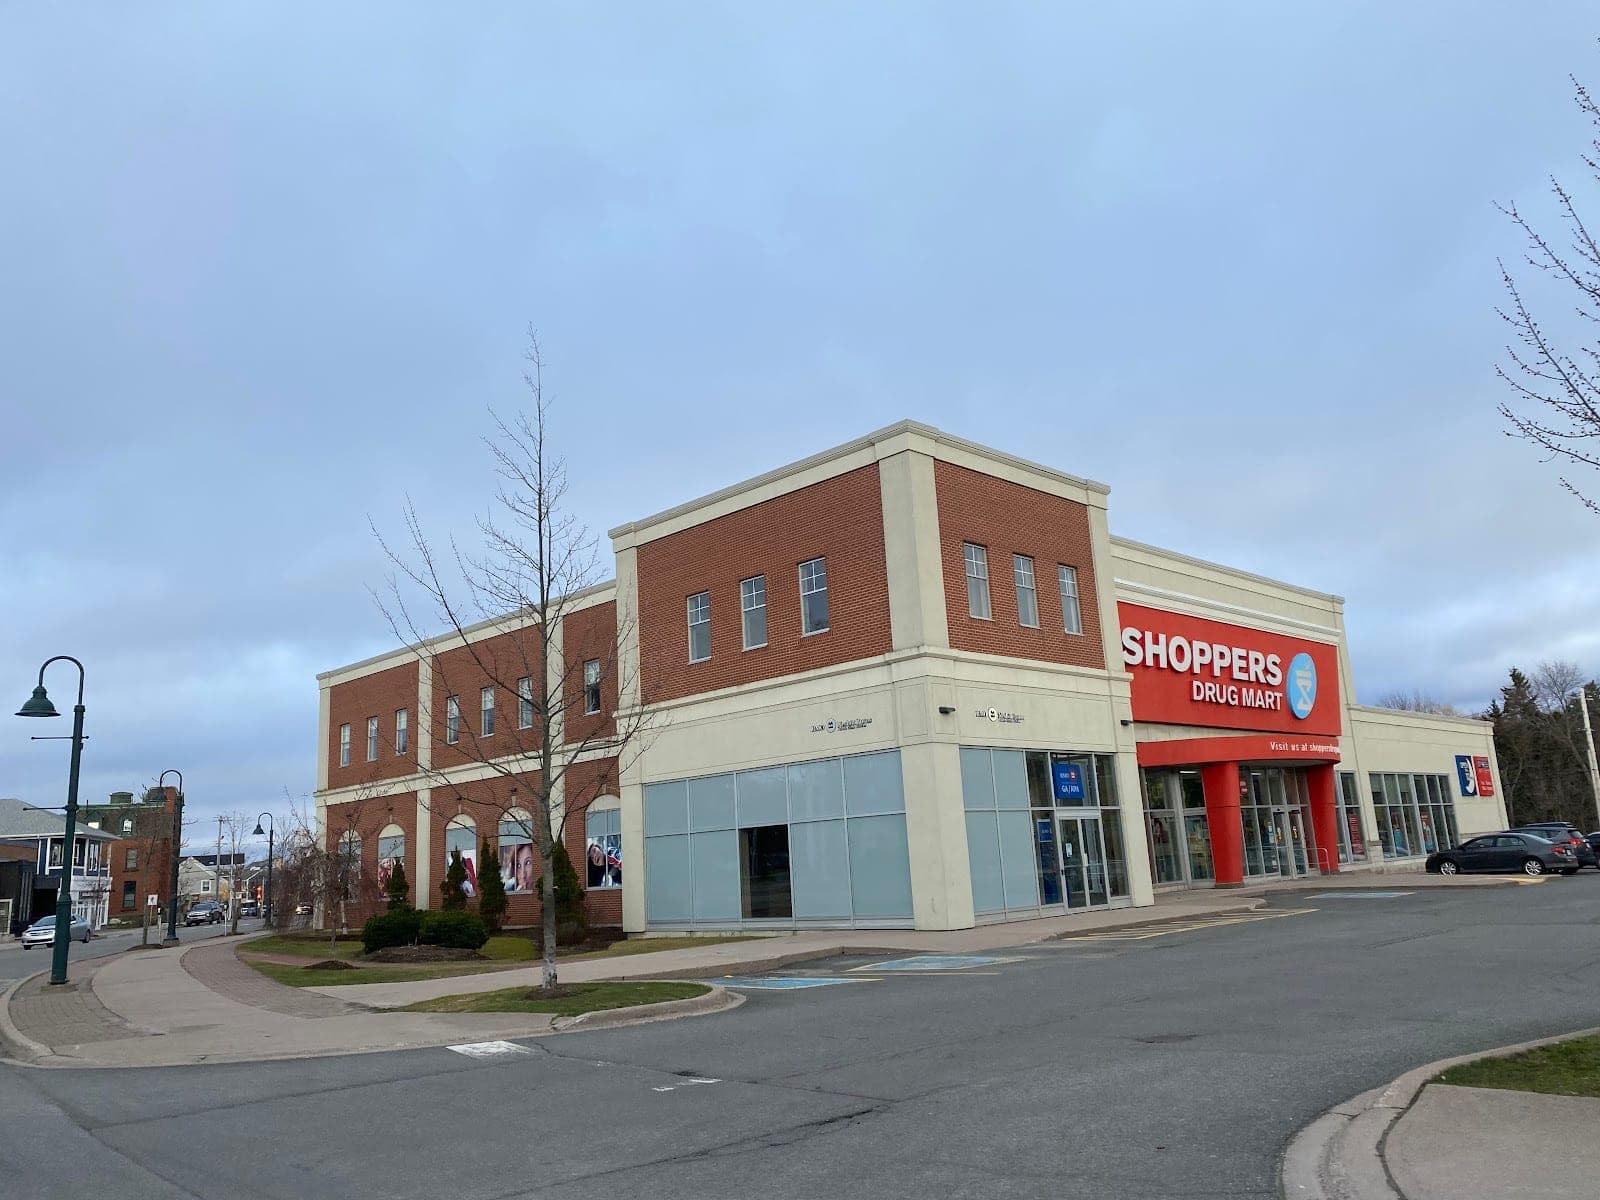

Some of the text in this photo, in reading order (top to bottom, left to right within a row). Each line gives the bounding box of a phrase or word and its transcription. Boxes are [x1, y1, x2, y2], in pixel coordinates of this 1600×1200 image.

[1121, 627, 1283, 686] SHOPPERS
[1192, 680, 1283, 711] DRUG MART
[1270, 741, 1289, 752] Visit
[1291, 743, 1300, 752] us
[1301, 742, 1308, 752] at
